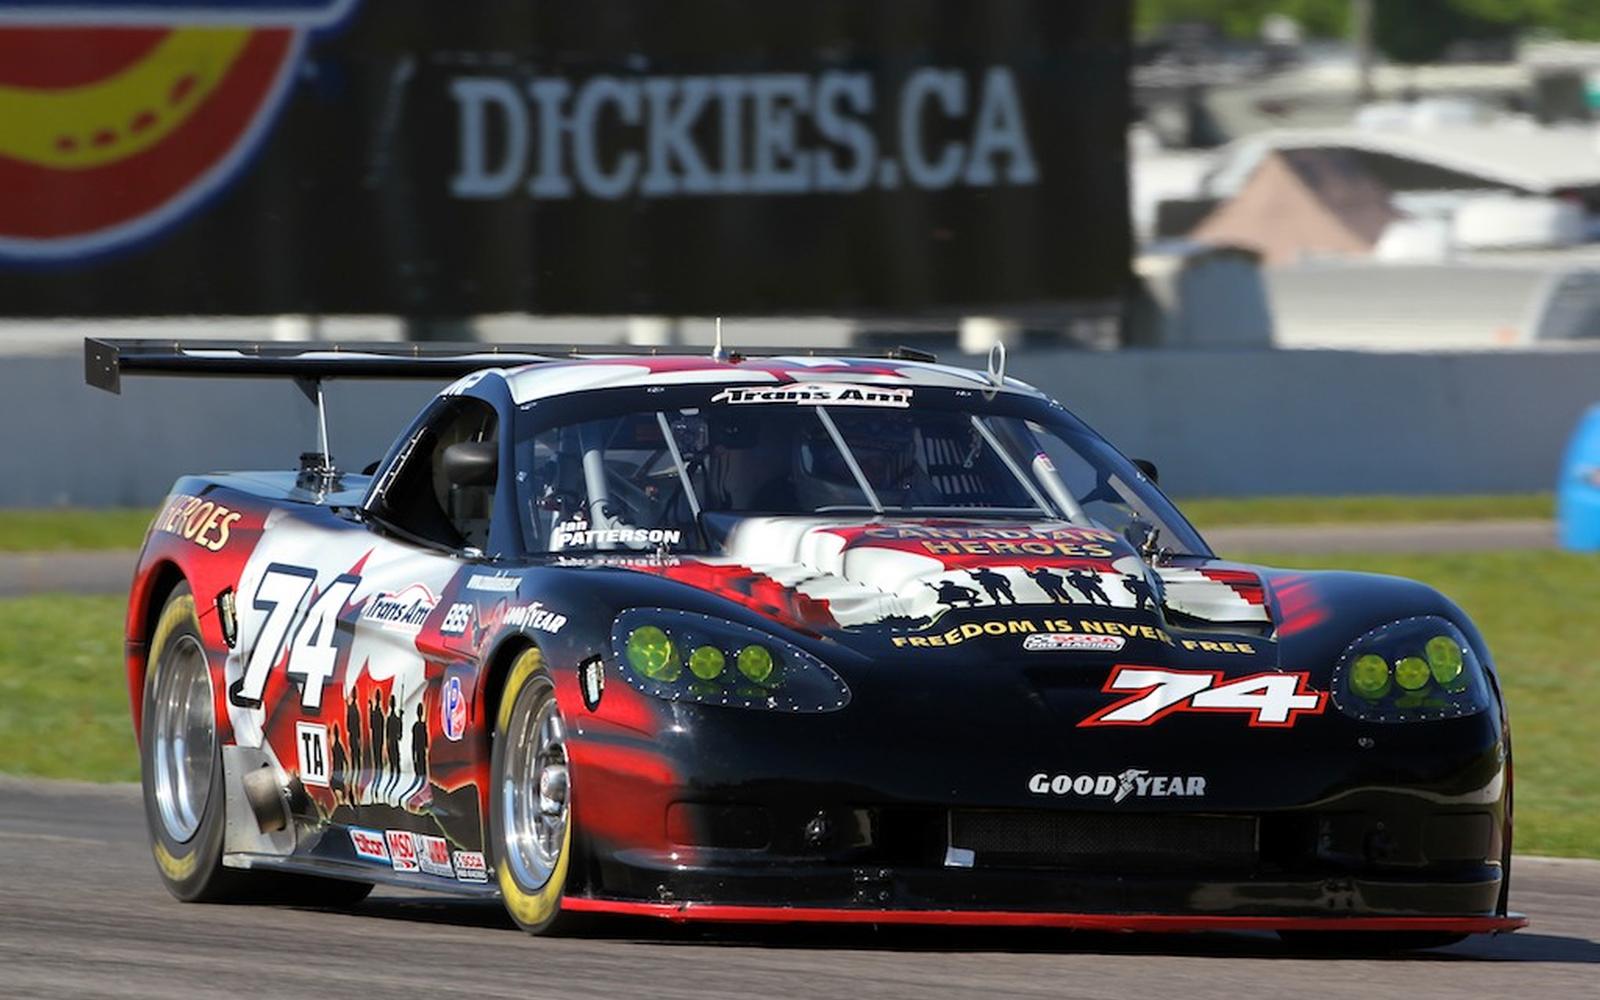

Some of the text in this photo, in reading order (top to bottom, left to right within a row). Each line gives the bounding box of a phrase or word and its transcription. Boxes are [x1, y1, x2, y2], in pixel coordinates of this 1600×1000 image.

[450, 66, 1037, 198] DICKIES.CA
[727, 389, 913, 404] Trans Am
[559, 529, 681, 548] PATTERSON
[560, 520, 588, 532] Ian
[865, 527, 1117, 543] CANADIAN
[922, 540, 1113, 558] HEROES
[366, 592, 431, 625] Trans Am
[440, 603, 474, 634] BBS
[231, 562, 361, 709] 74
[892, 619, 1255, 654] FREEDOM IS NEVER FREE
[1078, 665, 1327, 727] 74
[302, 732, 324, 776] TA
[1028, 770, 1206, 800] GOODYEAR
[388, 833, 415, 859] MSD
